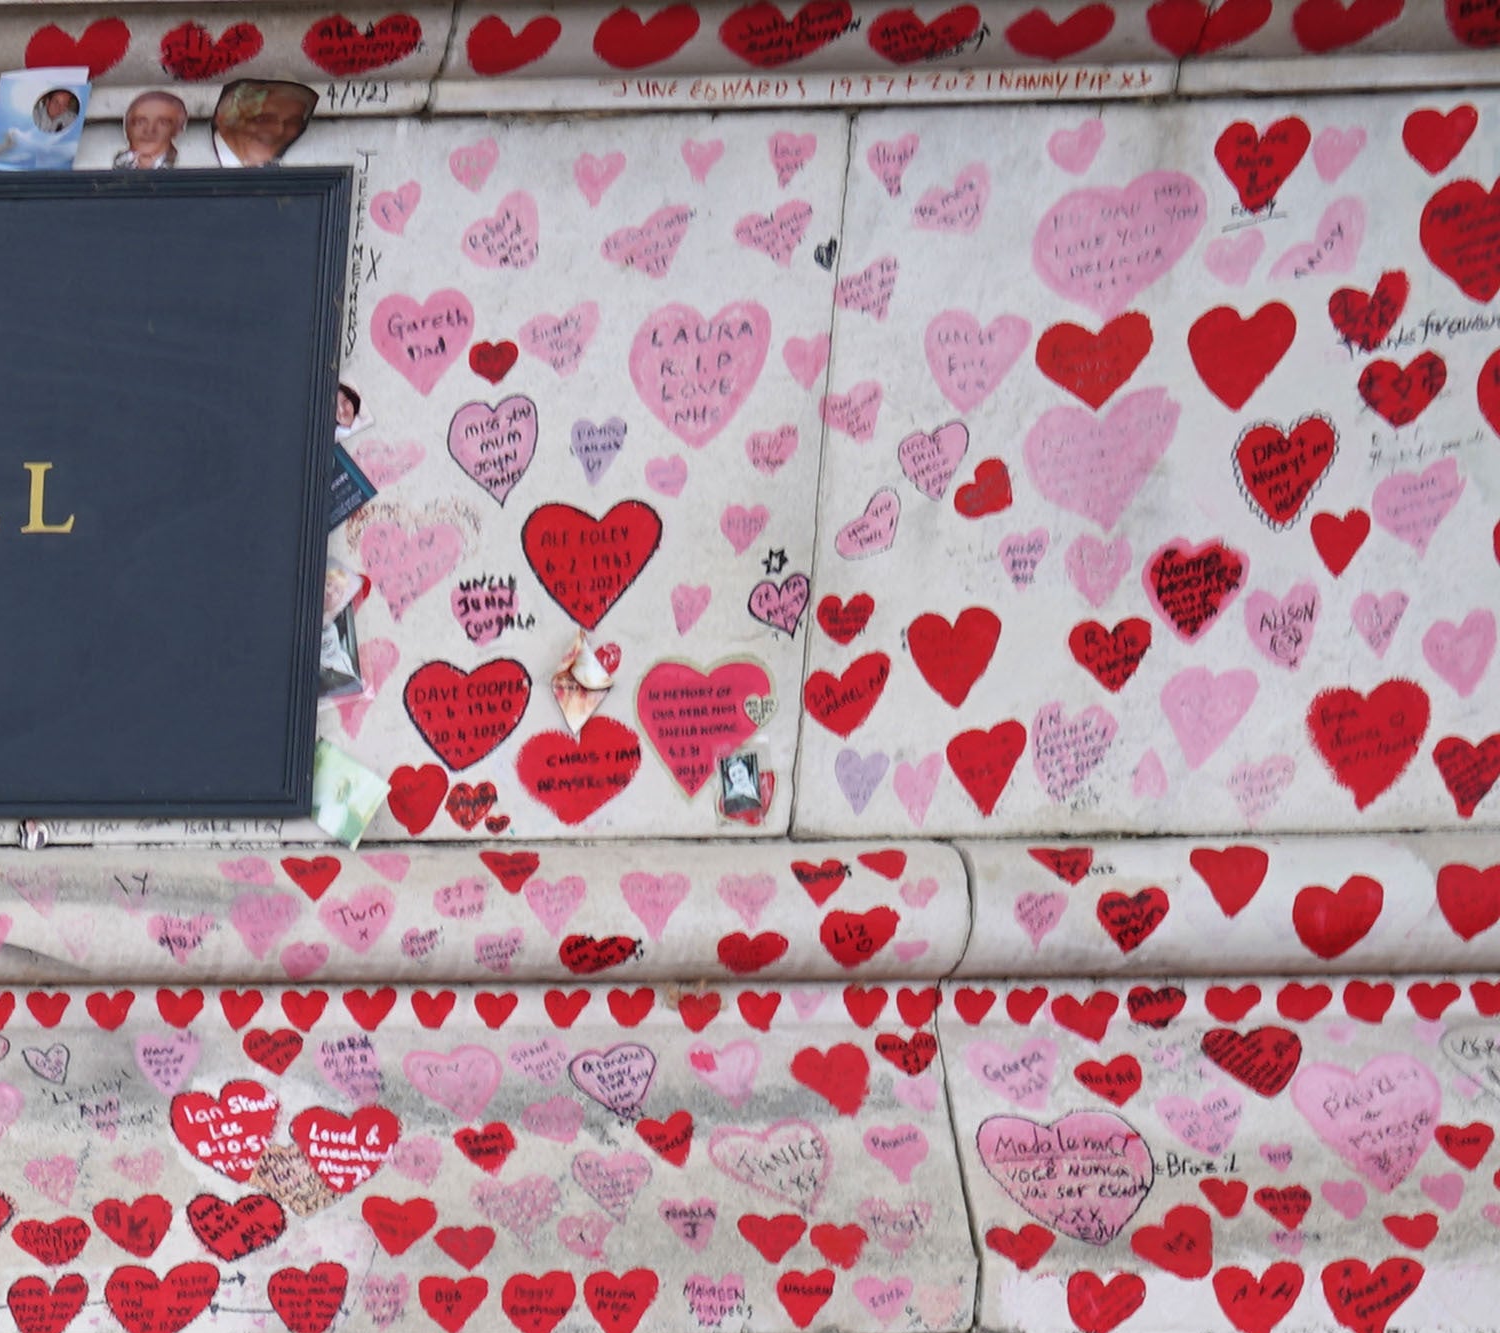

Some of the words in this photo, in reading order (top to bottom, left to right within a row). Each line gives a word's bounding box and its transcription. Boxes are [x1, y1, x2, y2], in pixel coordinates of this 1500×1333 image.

[388, 309, 468, 338] Gareth
[651, 322, 754, 347] LAURA
[407, 336, 446, 360] Dad
[308, 1123, 356, 1146] Loved
